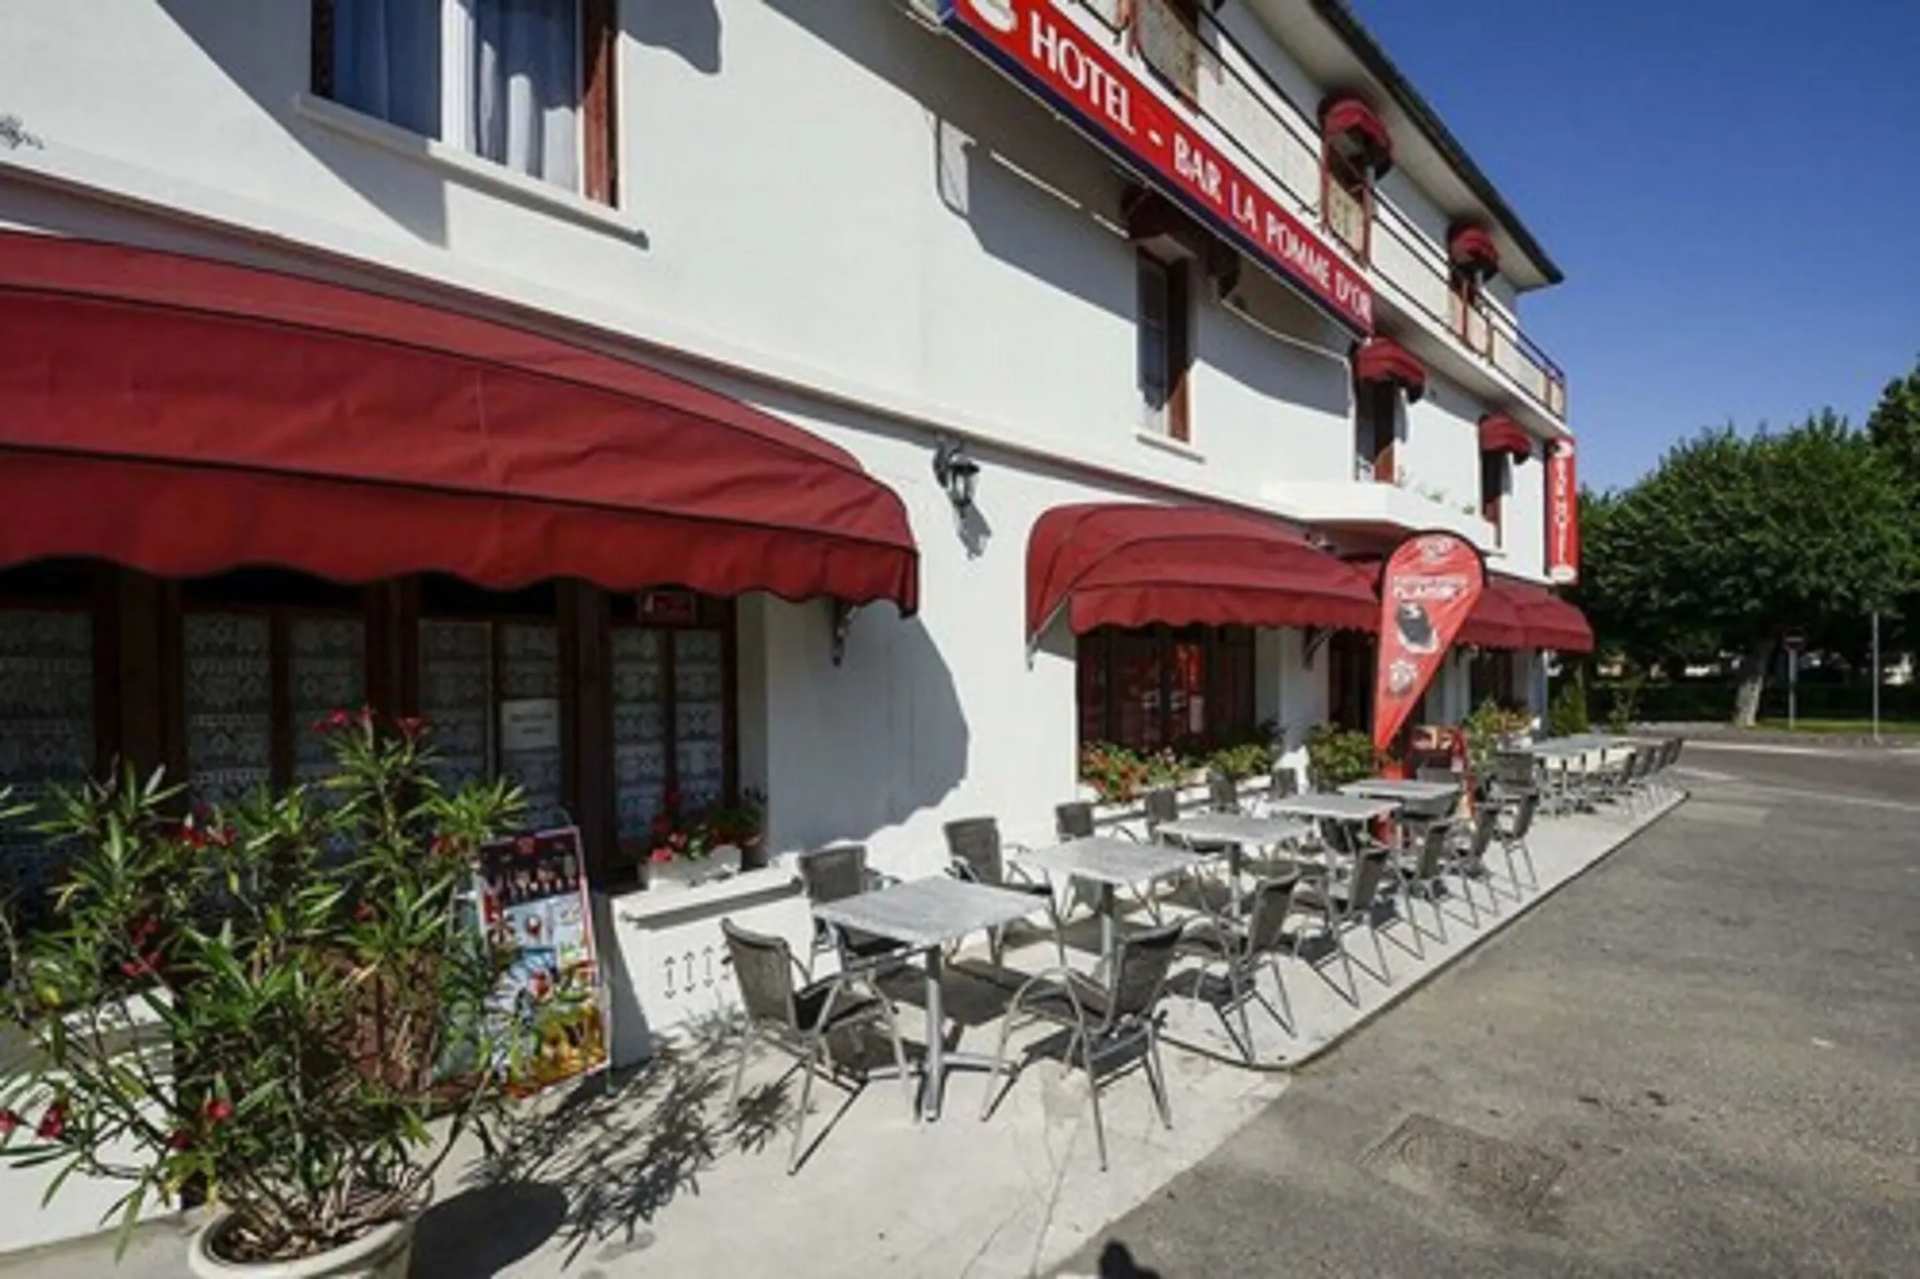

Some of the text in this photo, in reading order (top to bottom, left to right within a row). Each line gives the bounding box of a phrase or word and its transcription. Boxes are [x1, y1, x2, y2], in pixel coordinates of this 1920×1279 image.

[1030, 9, 1136, 135] HOTEL
[1173, 132, 1222, 204] BAR
[1232, 180, 1258, 233] LA
[1266, 210, 1330, 290] POMME
[1335, 271, 1373, 328] D'OR
